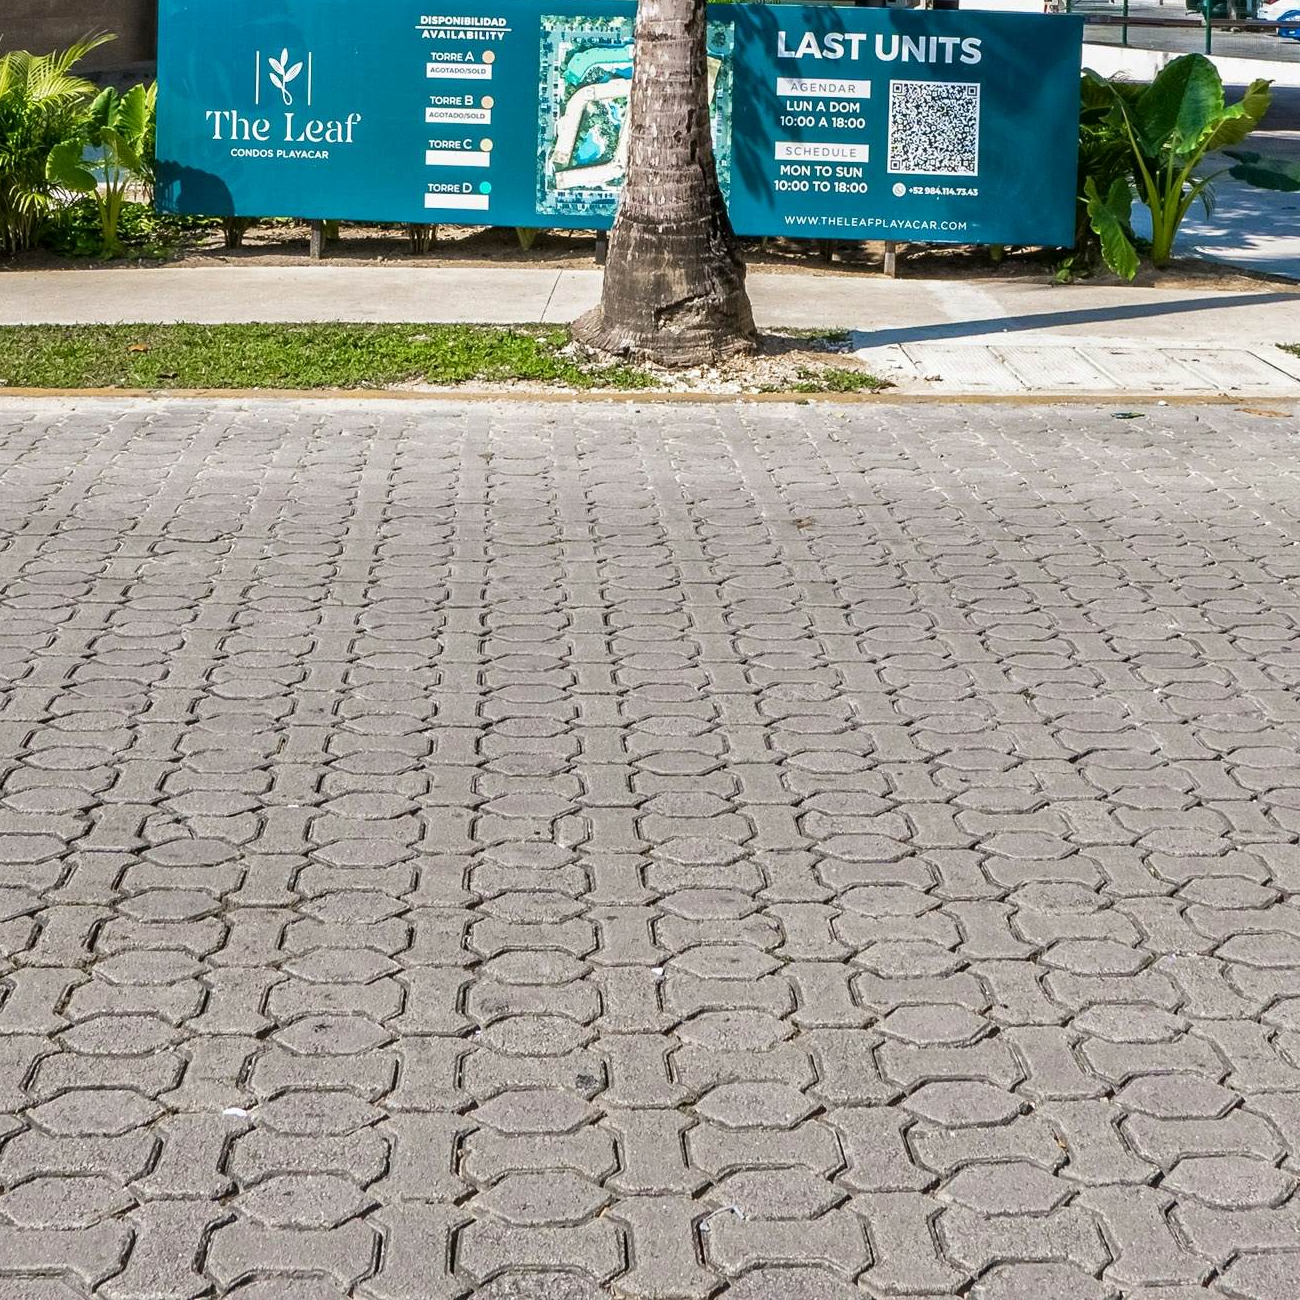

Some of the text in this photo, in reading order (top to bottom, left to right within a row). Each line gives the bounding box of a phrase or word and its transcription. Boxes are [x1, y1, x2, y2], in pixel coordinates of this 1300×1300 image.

[420, 15, 507, 27] DISPONIBILIDAD
[422, 30, 505, 41] AVAILABILITY
[777, 30, 982, 65] LAST UNITS
[430, 51, 475, 62] TORRE A
[790, 82, 856, 93] AGENDAR
[429, 95, 474, 106] TORRE B
[786, 100, 860, 113] LUN A DOM
[205, 110, 362, 143] The Leaf
[780, 116, 866, 129] 10:00 A 18:00
[428, 138, 473, 150] TORRE C
[230, 149, 329, 160] CONDOS PLAYACAR
[785, 146, 857, 158] SCHEDULE
[780, 165, 863, 178] MON TO SUN
[427, 182, 473, 193] TORRE D
[774, 180, 868, 193] 10:00 TO 18:00
[908, 186, 979, 196] +52 984.114.73.43
[784, 215, 967, 231] WWW.THELEAFPLAYACAR.COM
